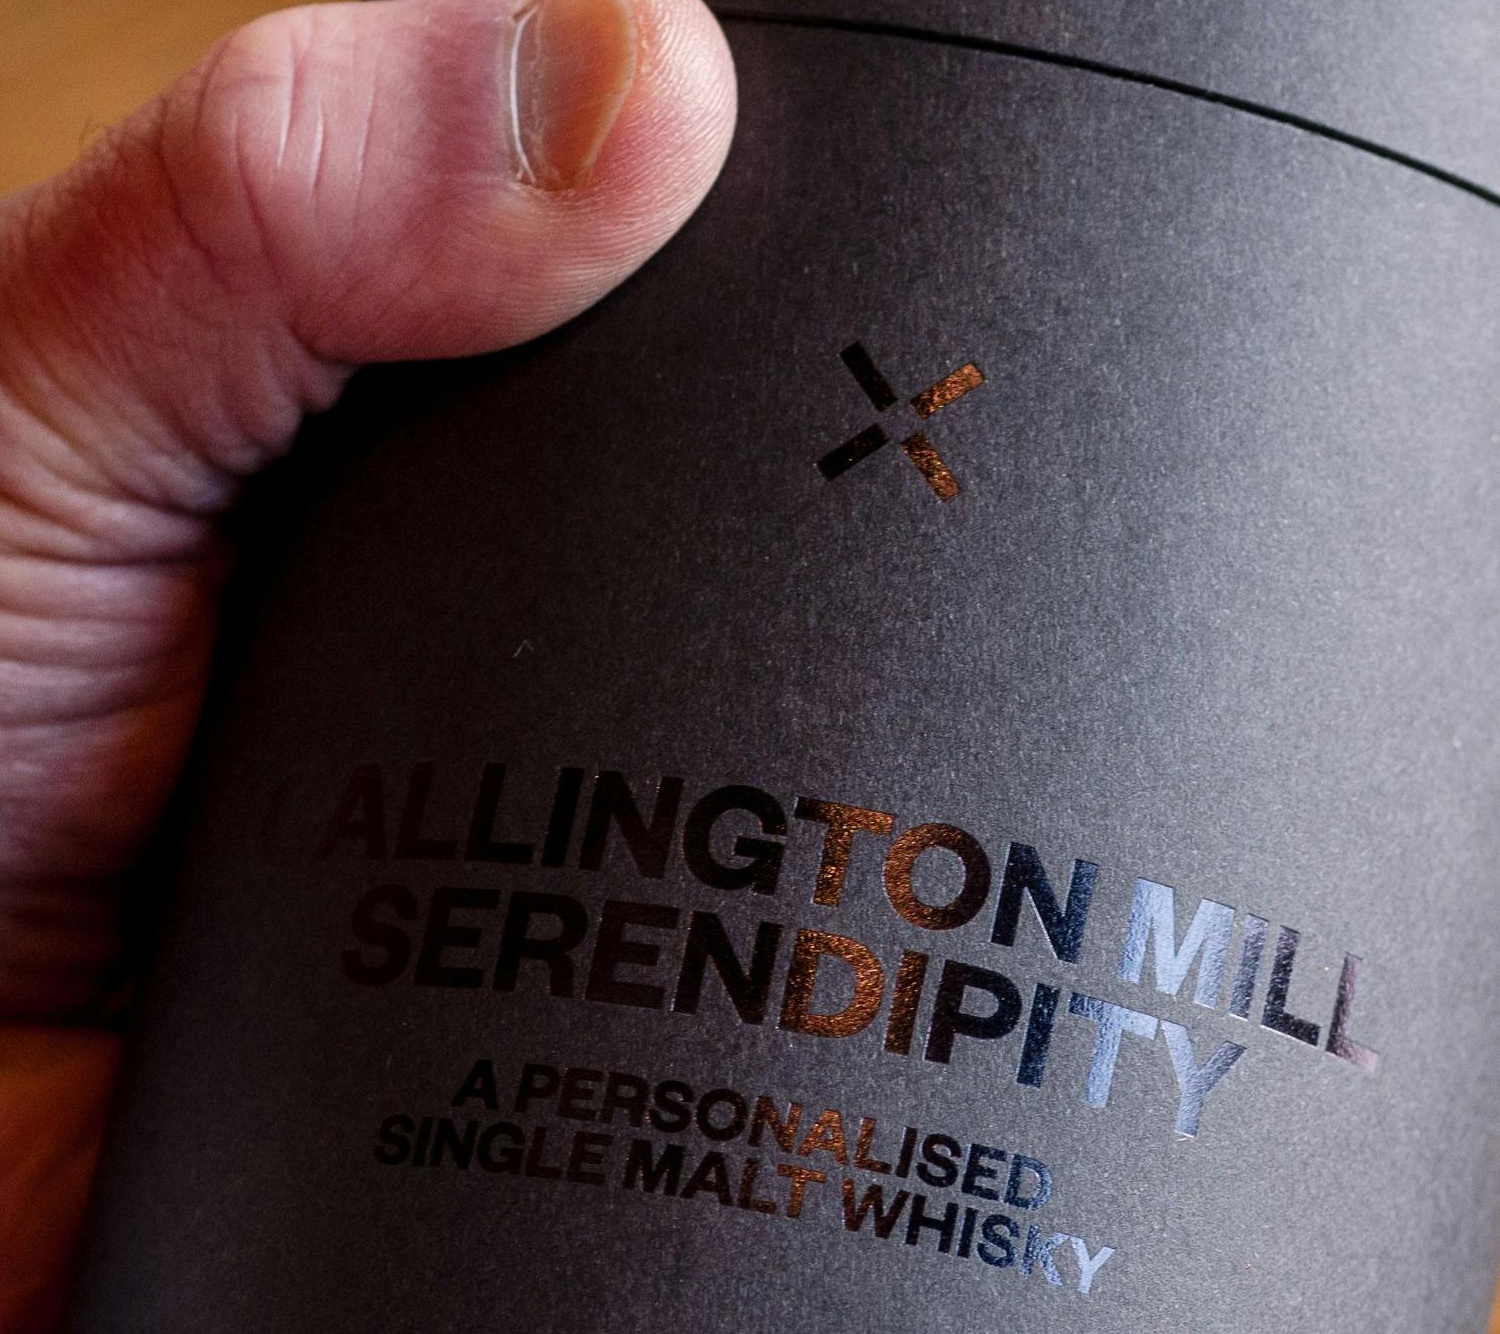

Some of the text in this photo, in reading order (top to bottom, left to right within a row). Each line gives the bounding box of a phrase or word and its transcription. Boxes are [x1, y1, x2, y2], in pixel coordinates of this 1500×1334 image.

[339, 883, 1248, 1139] SERENDIPITY
[1119, 876, 1380, 1069] MILL
[373, 1111, 1118, 1295] SINGLE MALT WHISKY
[450, 1058, 1054, 1213] A PERSONALISED
